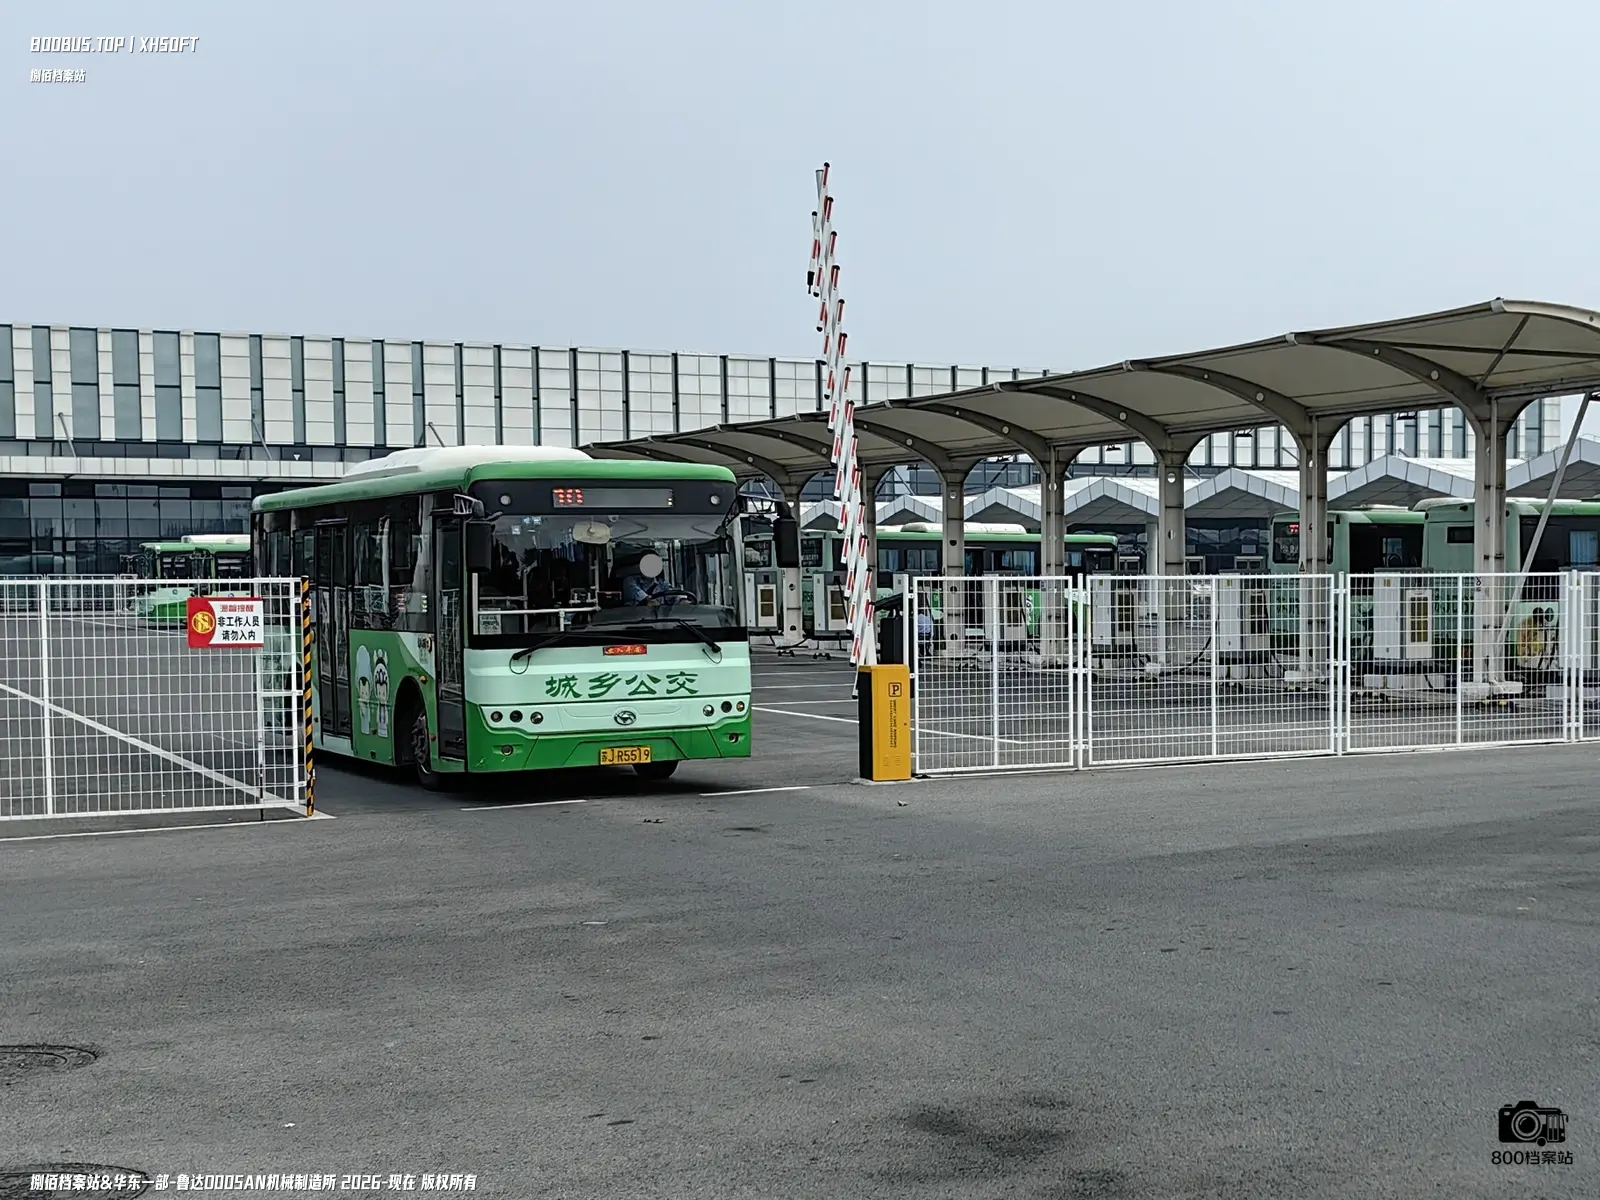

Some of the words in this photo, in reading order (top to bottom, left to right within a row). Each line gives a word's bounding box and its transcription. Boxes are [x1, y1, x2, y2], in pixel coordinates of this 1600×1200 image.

[217, 615, 260, 627] 非工作人员
[222, 630, 256, 641] 请勿入内
[545, 671, 699, 698] 城乡公交
[892, 684, 900, 695] P
